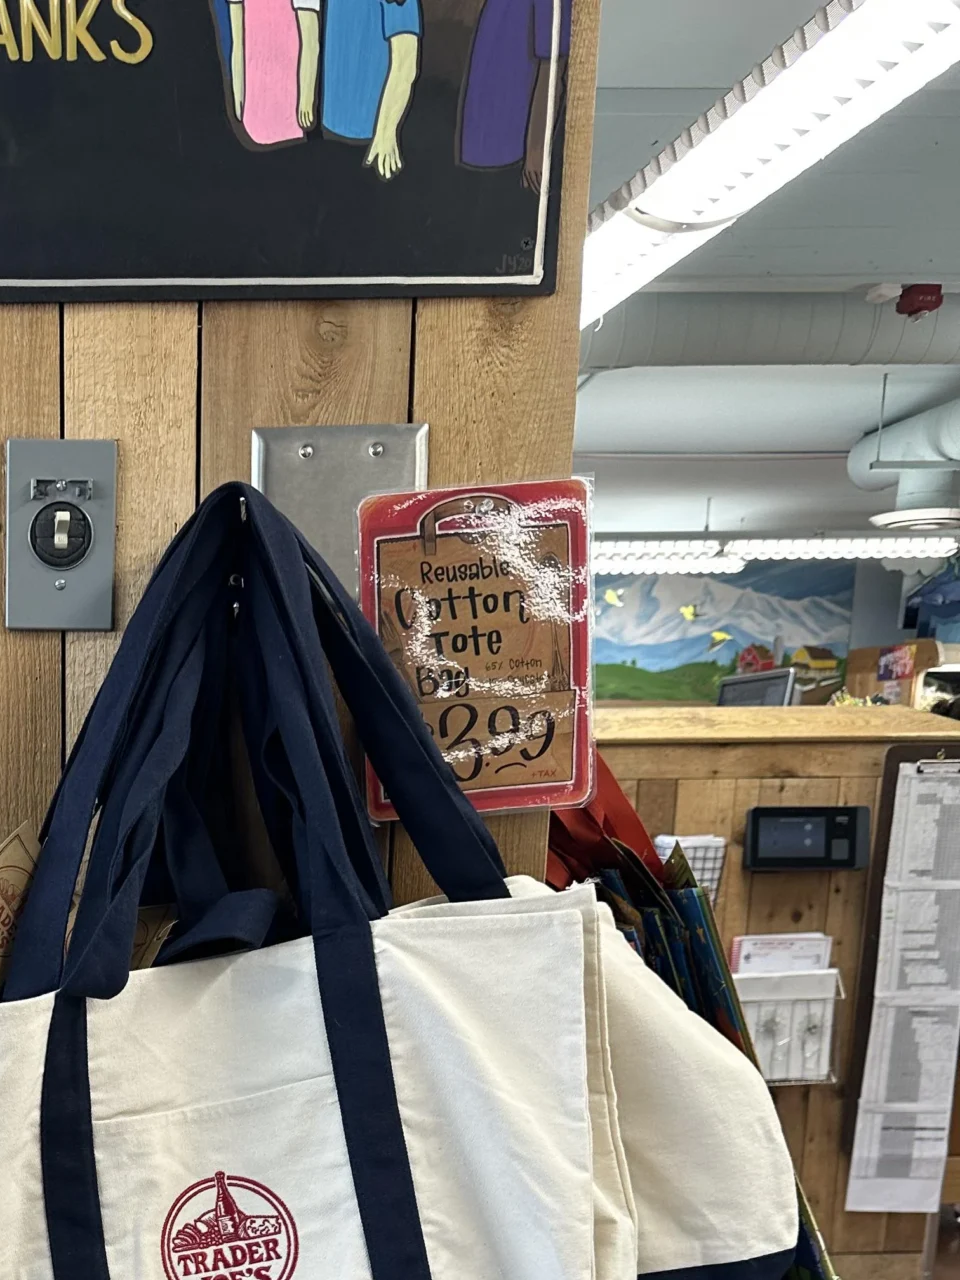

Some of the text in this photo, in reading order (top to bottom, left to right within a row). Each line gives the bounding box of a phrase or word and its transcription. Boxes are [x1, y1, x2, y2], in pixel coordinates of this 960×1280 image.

[420, 557, 510, 585] Reusable
[394, 586, 530, 630] Cotton
[177, 1237, 282, 1277] TRADER
